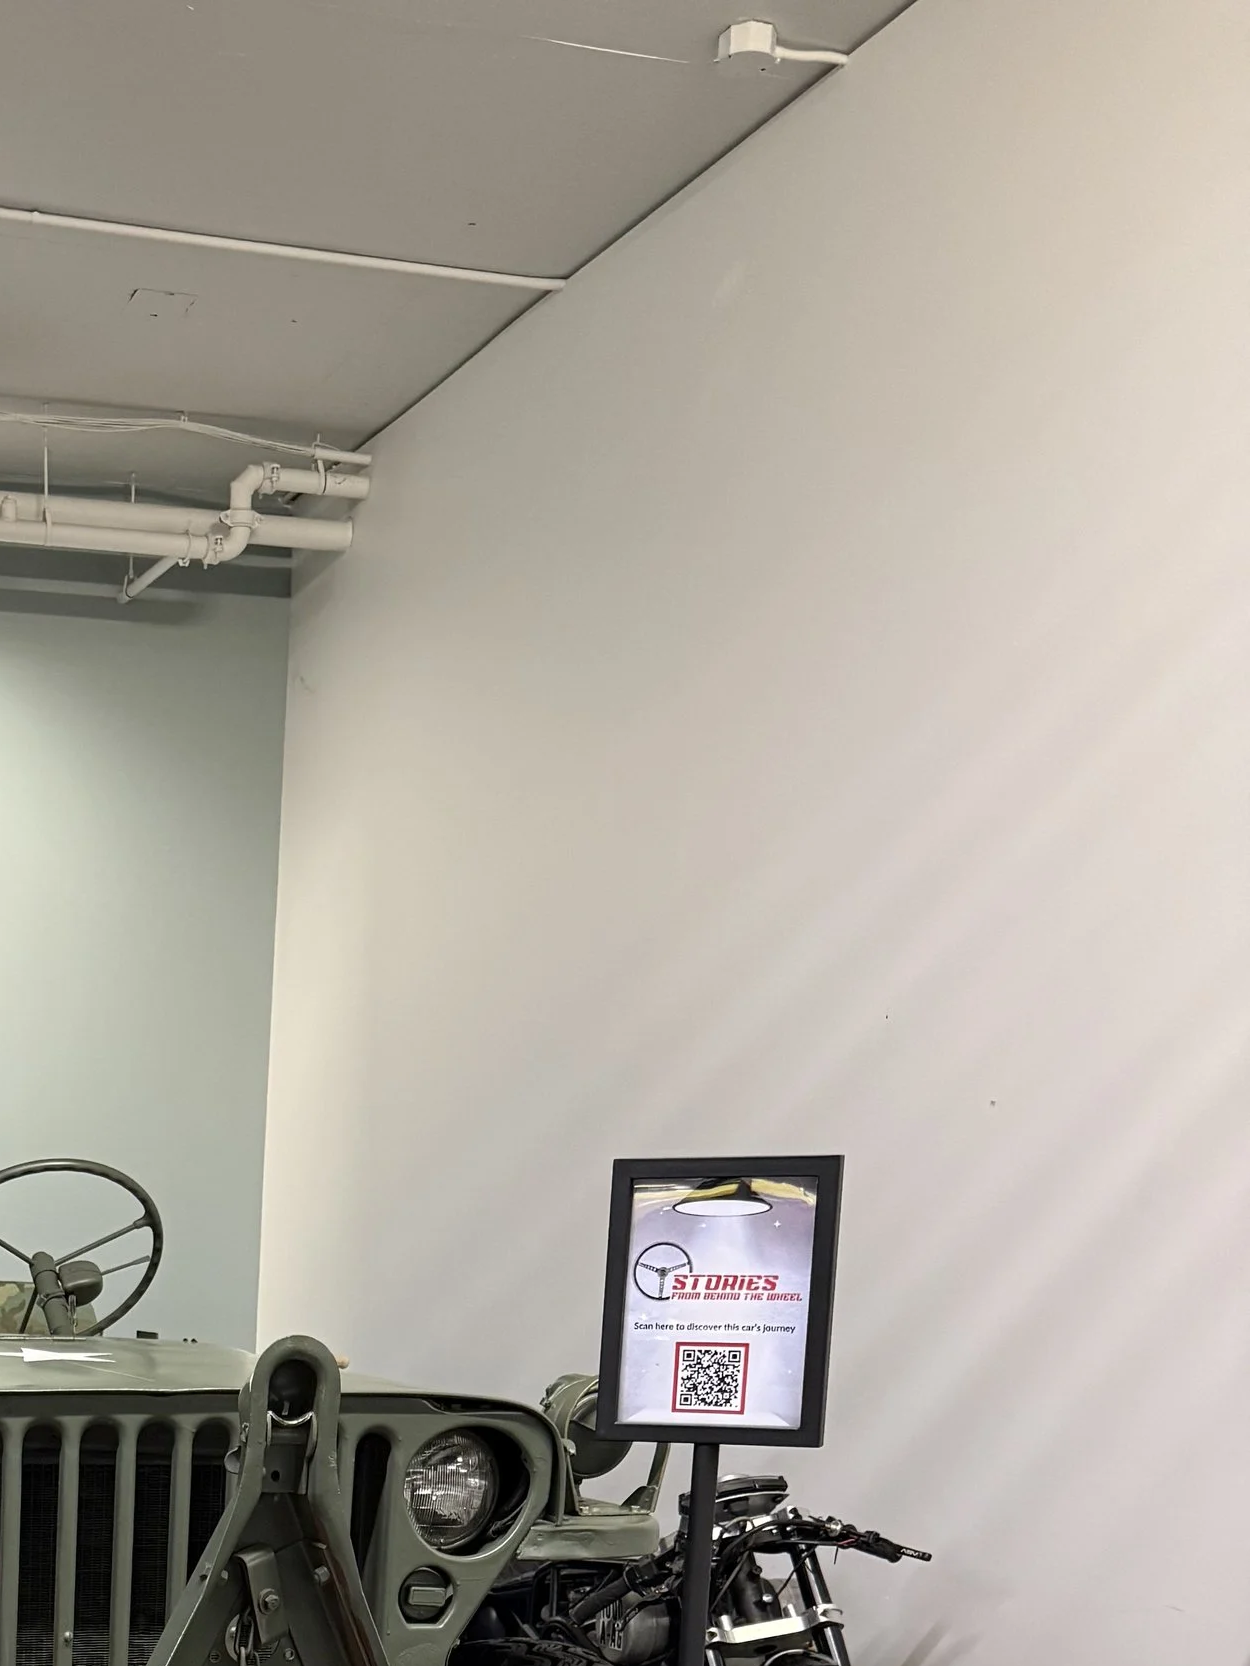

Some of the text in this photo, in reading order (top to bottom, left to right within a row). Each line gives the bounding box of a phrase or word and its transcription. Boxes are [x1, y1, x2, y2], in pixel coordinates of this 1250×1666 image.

[670, 1292, 803, 1301] FROM BEHIND THE WHEEL
[634, 1322, 796, 1334] Scan here to discover this car's journey
